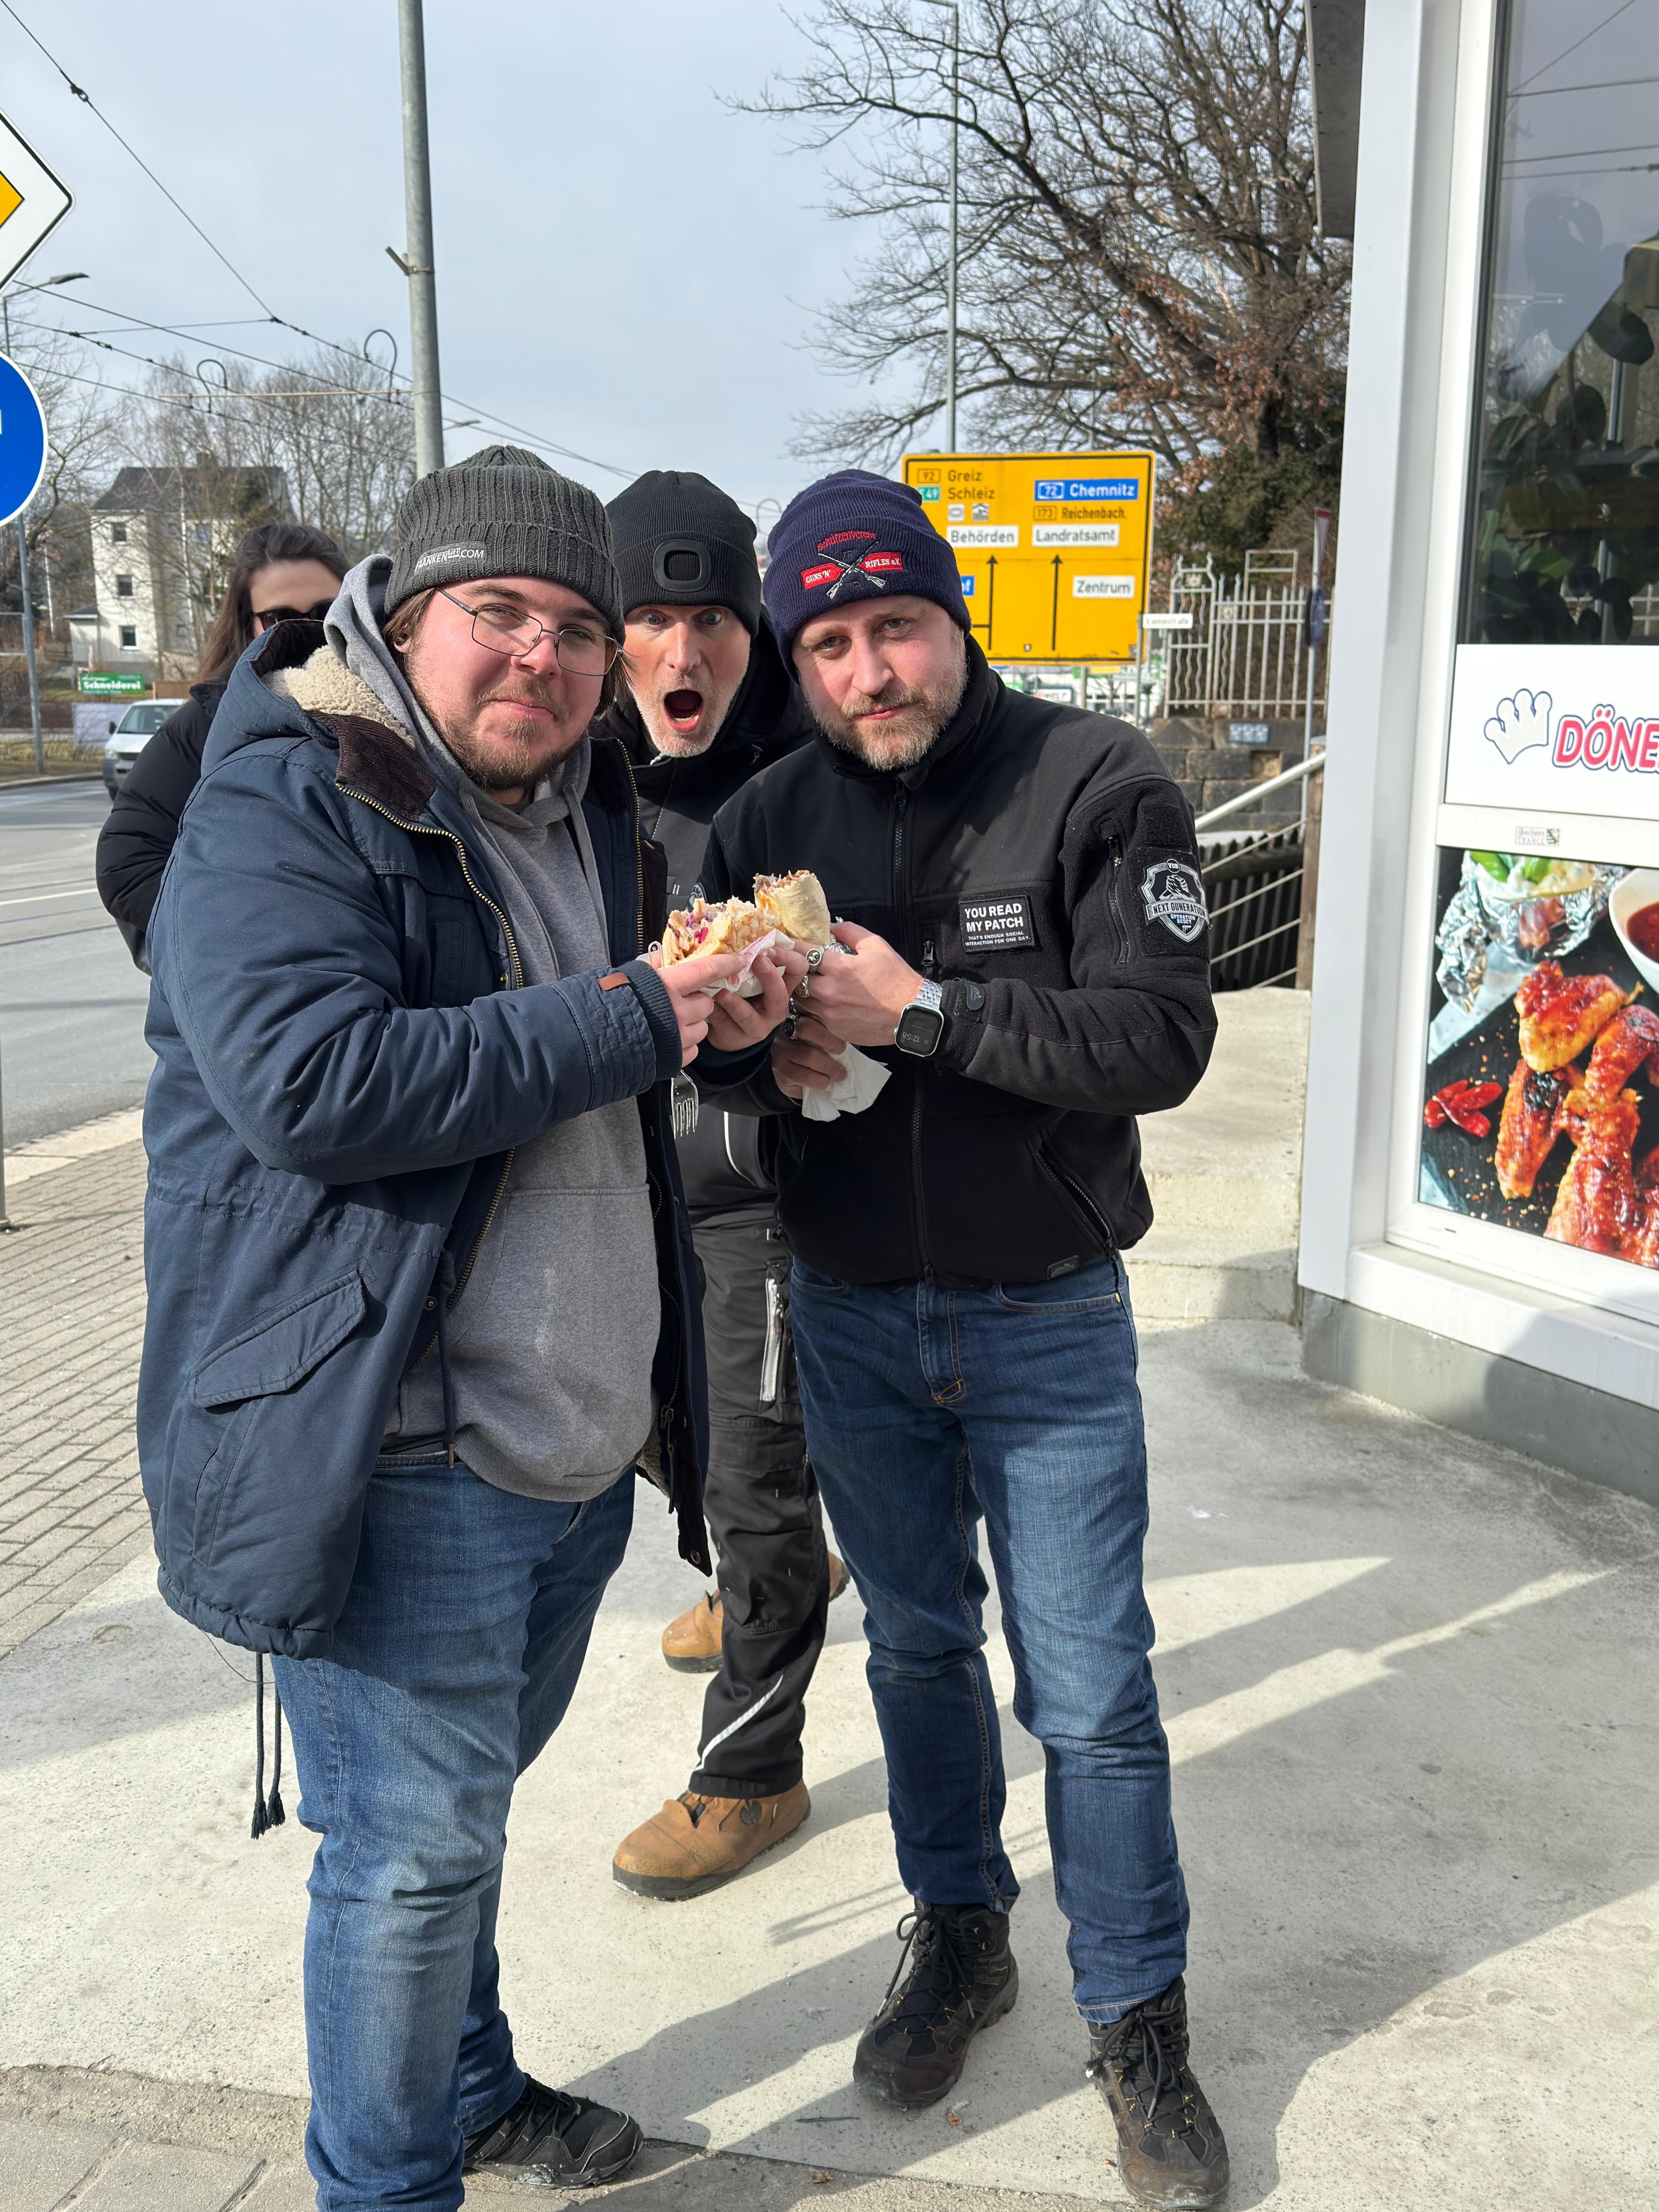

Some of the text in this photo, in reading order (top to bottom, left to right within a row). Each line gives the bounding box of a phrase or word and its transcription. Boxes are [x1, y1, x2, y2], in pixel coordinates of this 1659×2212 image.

[922, 470, 982, 482] 92 Greiz
[947, 487, 995, 499] Schleiz
[1045, 483, 1136, 497] 72 Chemnitz
[1037, 505, 1125, 519] 173 Reichenbach
[950, 529, 1015, 543] Behörden
[1036, 529, 1115, 542] Landratsamt
[864, 558, 890, 568] RIFLES
[806, 574, 822, 583] GUNS
[1077, 580, 1131, 594] Zentrum
[83, 681, 141, 690] Schneiderei
[1554, 706, 1659, 771] DÖNE
[964, 903, 1022, 918] YOU READ
[1153, 902, 1206, 918] NEXT GUNERATION
[966, 916, 1023, 932] MY PATCH
[902, 1032, 920, 1043] 12:58
